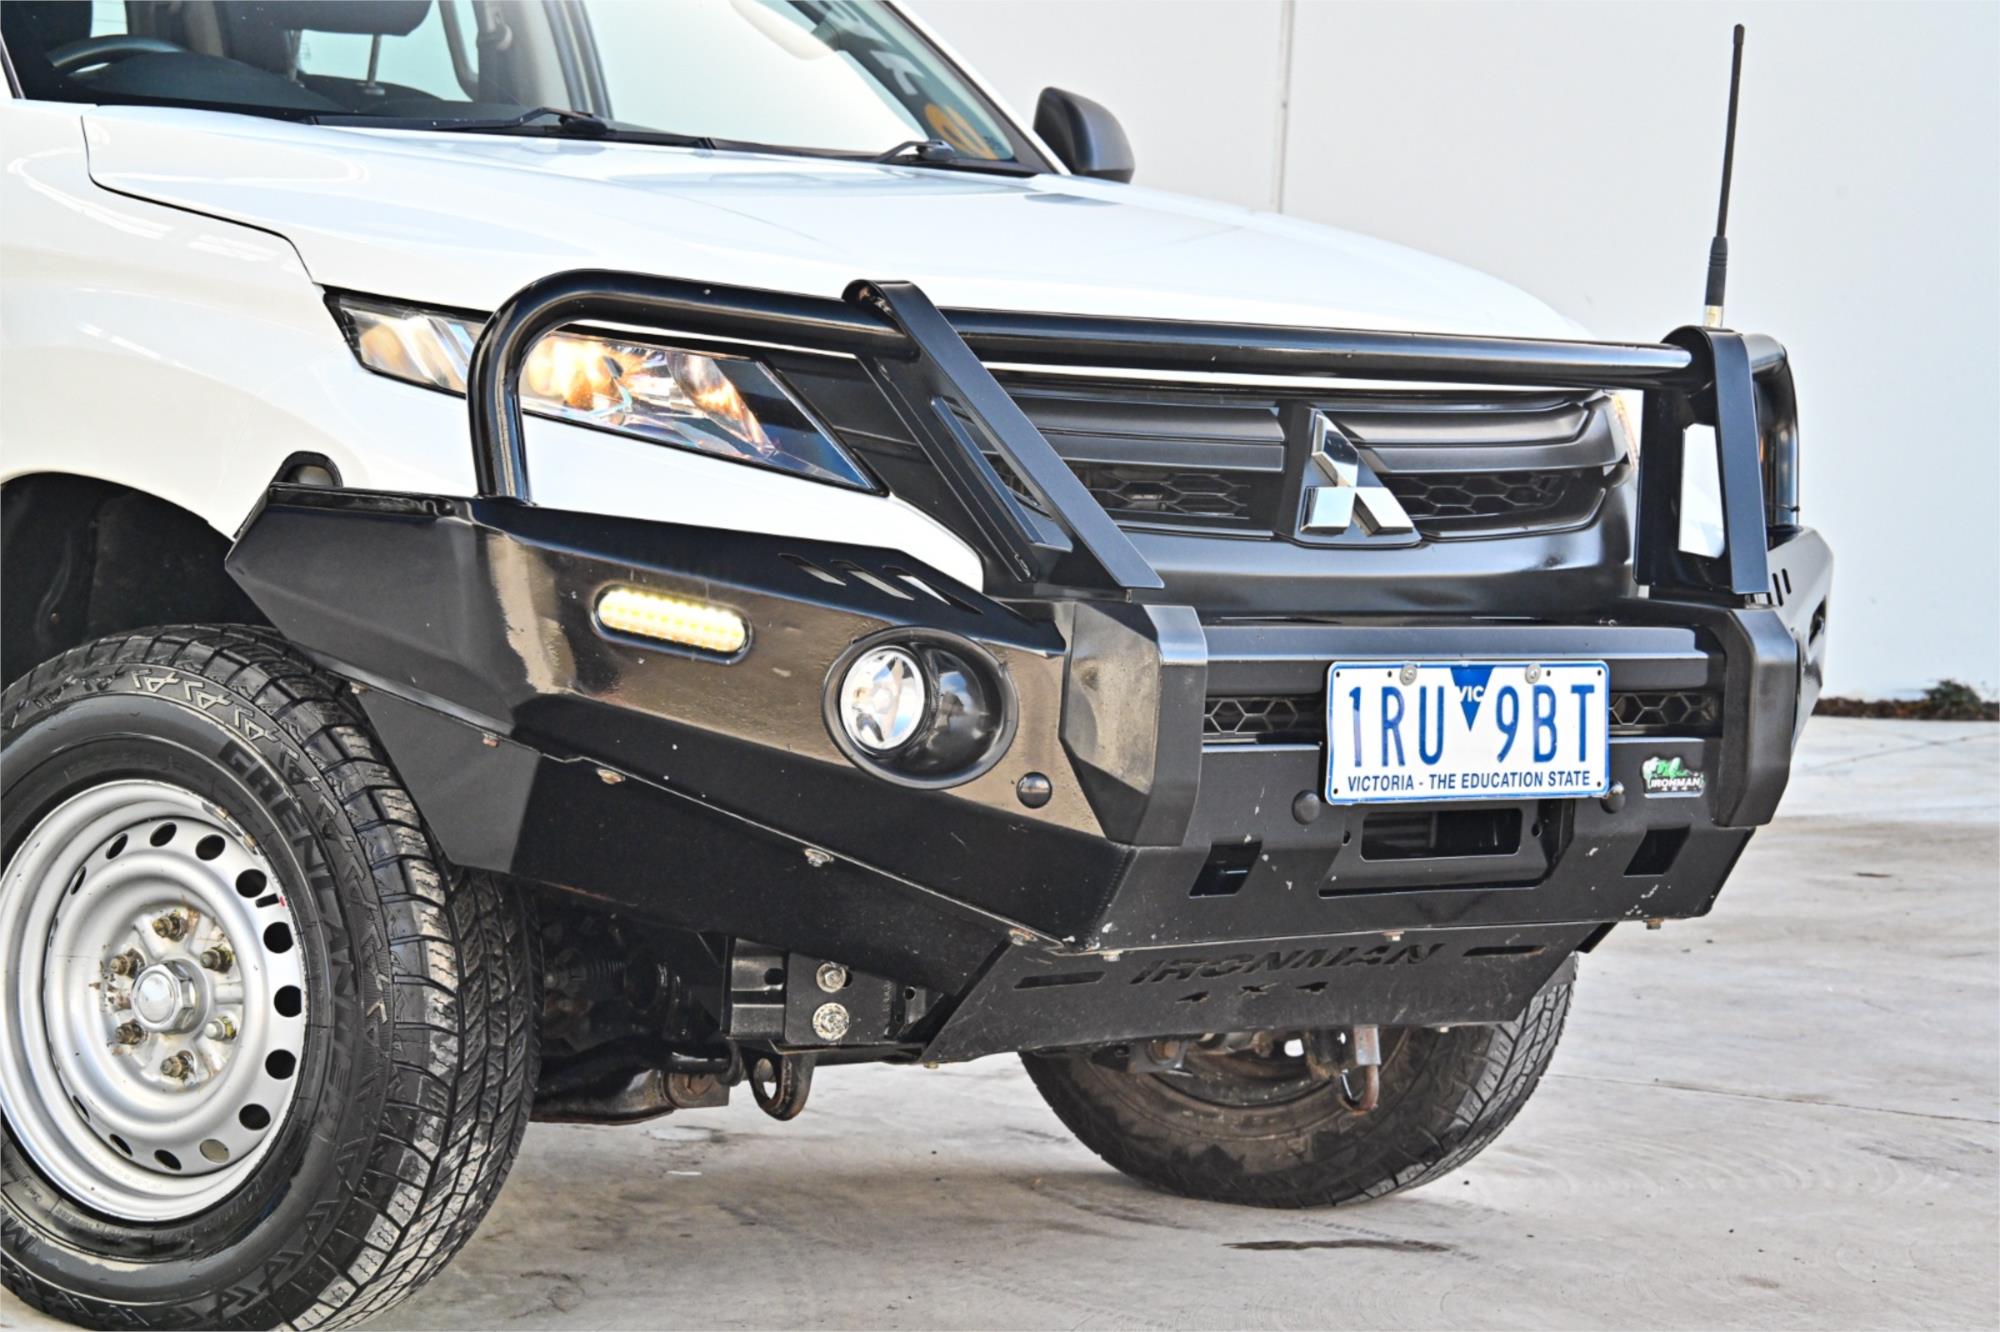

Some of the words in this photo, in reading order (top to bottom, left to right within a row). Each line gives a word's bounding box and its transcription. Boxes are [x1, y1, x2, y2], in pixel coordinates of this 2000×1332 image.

[1454, 684, 1486, 703] VIC
[1348, 684, 1445, 768] 1RU
[1495, 683, 1596, 764] 9BT
[1347, 773, 1415, 793] VICTORIA
[1428, 773, 1459, 790] THE
[1461, 772, 1546, 789] EDUCATION
[1547, 770, 1591, 787] STATE
[1650, 776, 1700, 788] IRONMAN
